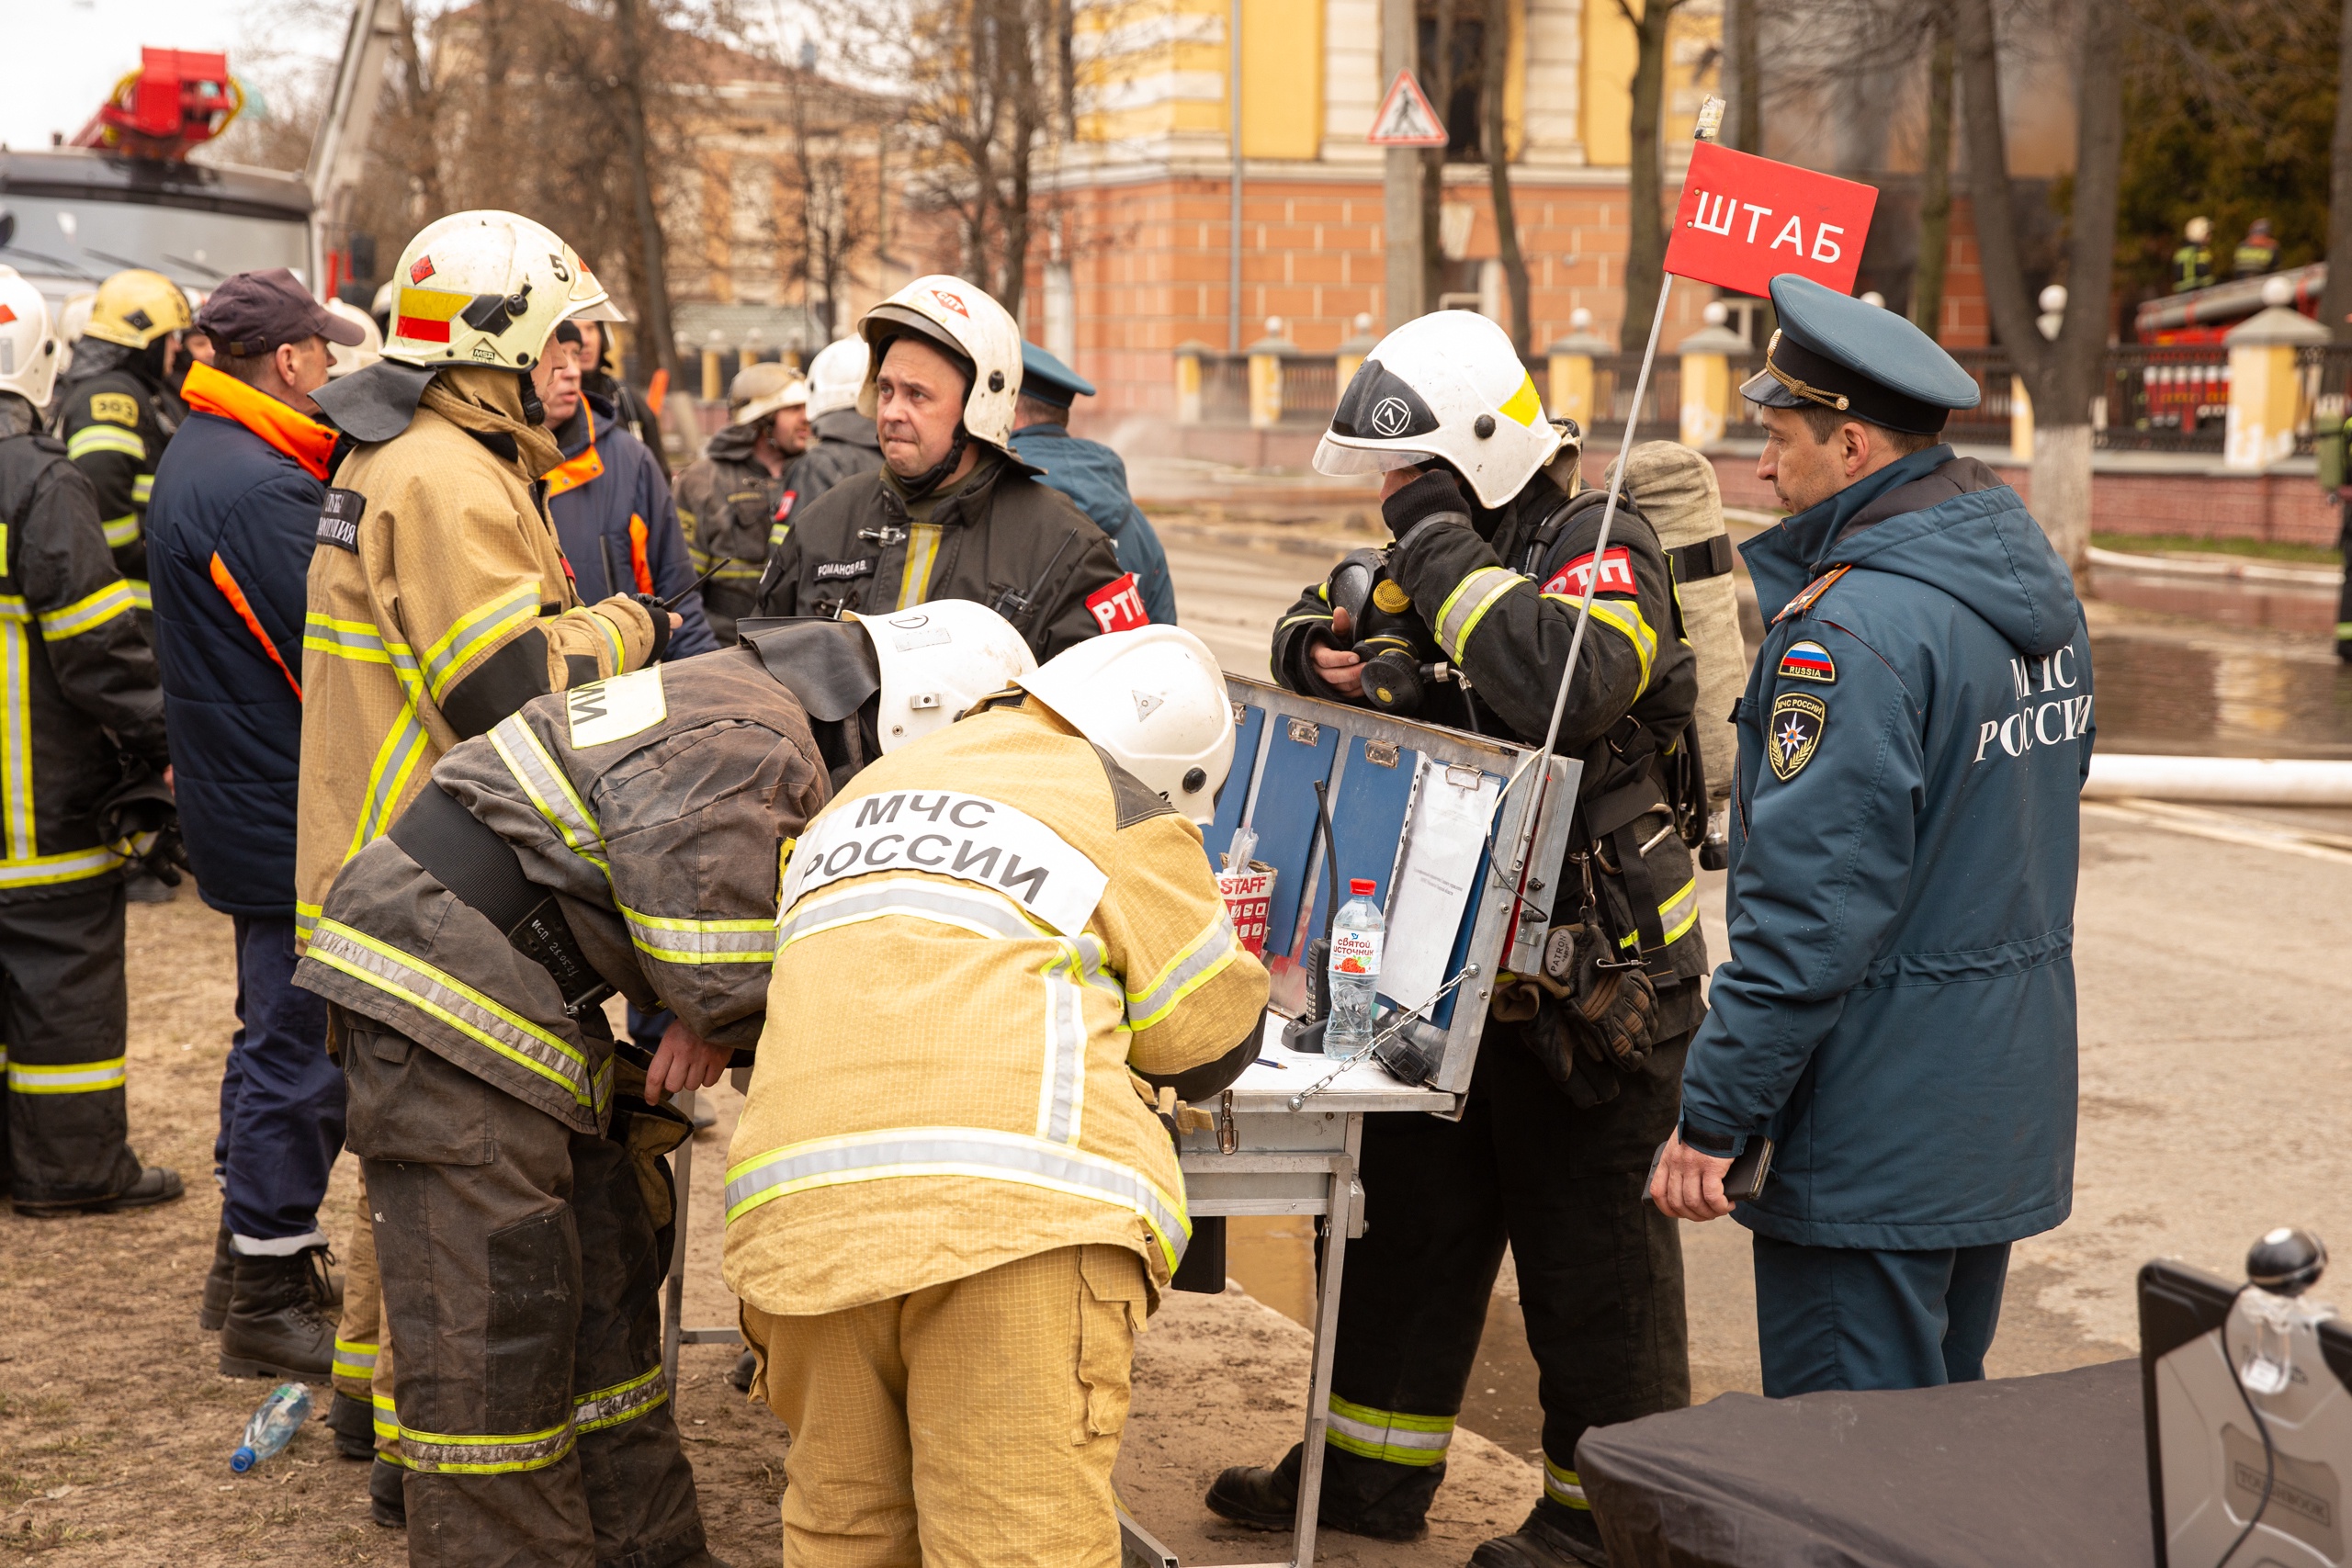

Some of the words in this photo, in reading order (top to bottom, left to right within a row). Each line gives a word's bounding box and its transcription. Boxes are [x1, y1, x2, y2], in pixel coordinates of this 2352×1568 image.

[1693, 190, 1845, 264] ШТАБ
[548, 254, 570, 282] 5
[936, 291, 966, 311] СПТ
[474, 349, 495, 360] MSA
[1789, 666, 1821, 678] RUSSIA
[1777, 699, 1792, 710] МЧС
[1792, 699, 1823, 716] РОССИИ
[1973, 694, 2093, 763] РОССИИ
[854, 794, 996, 829] МЧС
[802, 834, 1050, 905] РОССИИ
[1219, 875, 1267, 896] STAFF
[1550, 934, 1566, 972] PATRON
